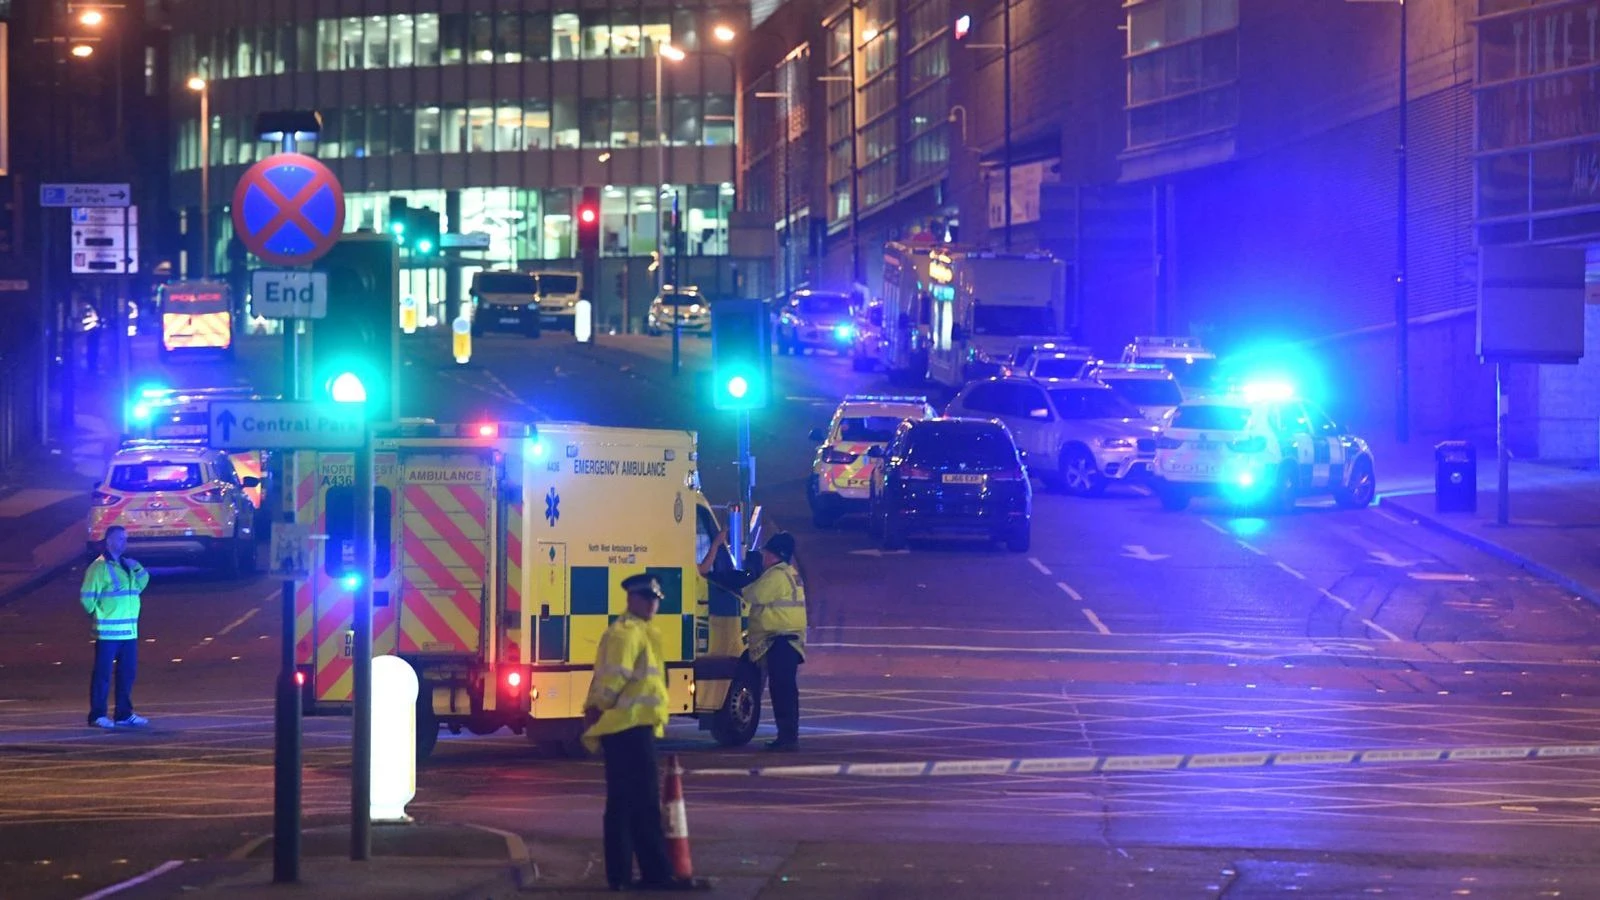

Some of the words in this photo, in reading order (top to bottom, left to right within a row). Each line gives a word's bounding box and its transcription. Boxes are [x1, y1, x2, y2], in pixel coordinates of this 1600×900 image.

[265, 281, 314, 303] End
[242, 416, 309, 432] Central
[322, 464, 354, 475] NORT
[374, 464, 394, 475] EST
[573, 459, 619, 475] EMERGENCY
[621, 462, 666, 477] AMBULANCE
[1171, 463, 1223, 473] POLIC
[321, 475, 353, 486] A436
[408, 470, 482, 481] AMBULANCE
[612, 544, 633, 552] Ambulance
[633, 544, 648, 553] Service
